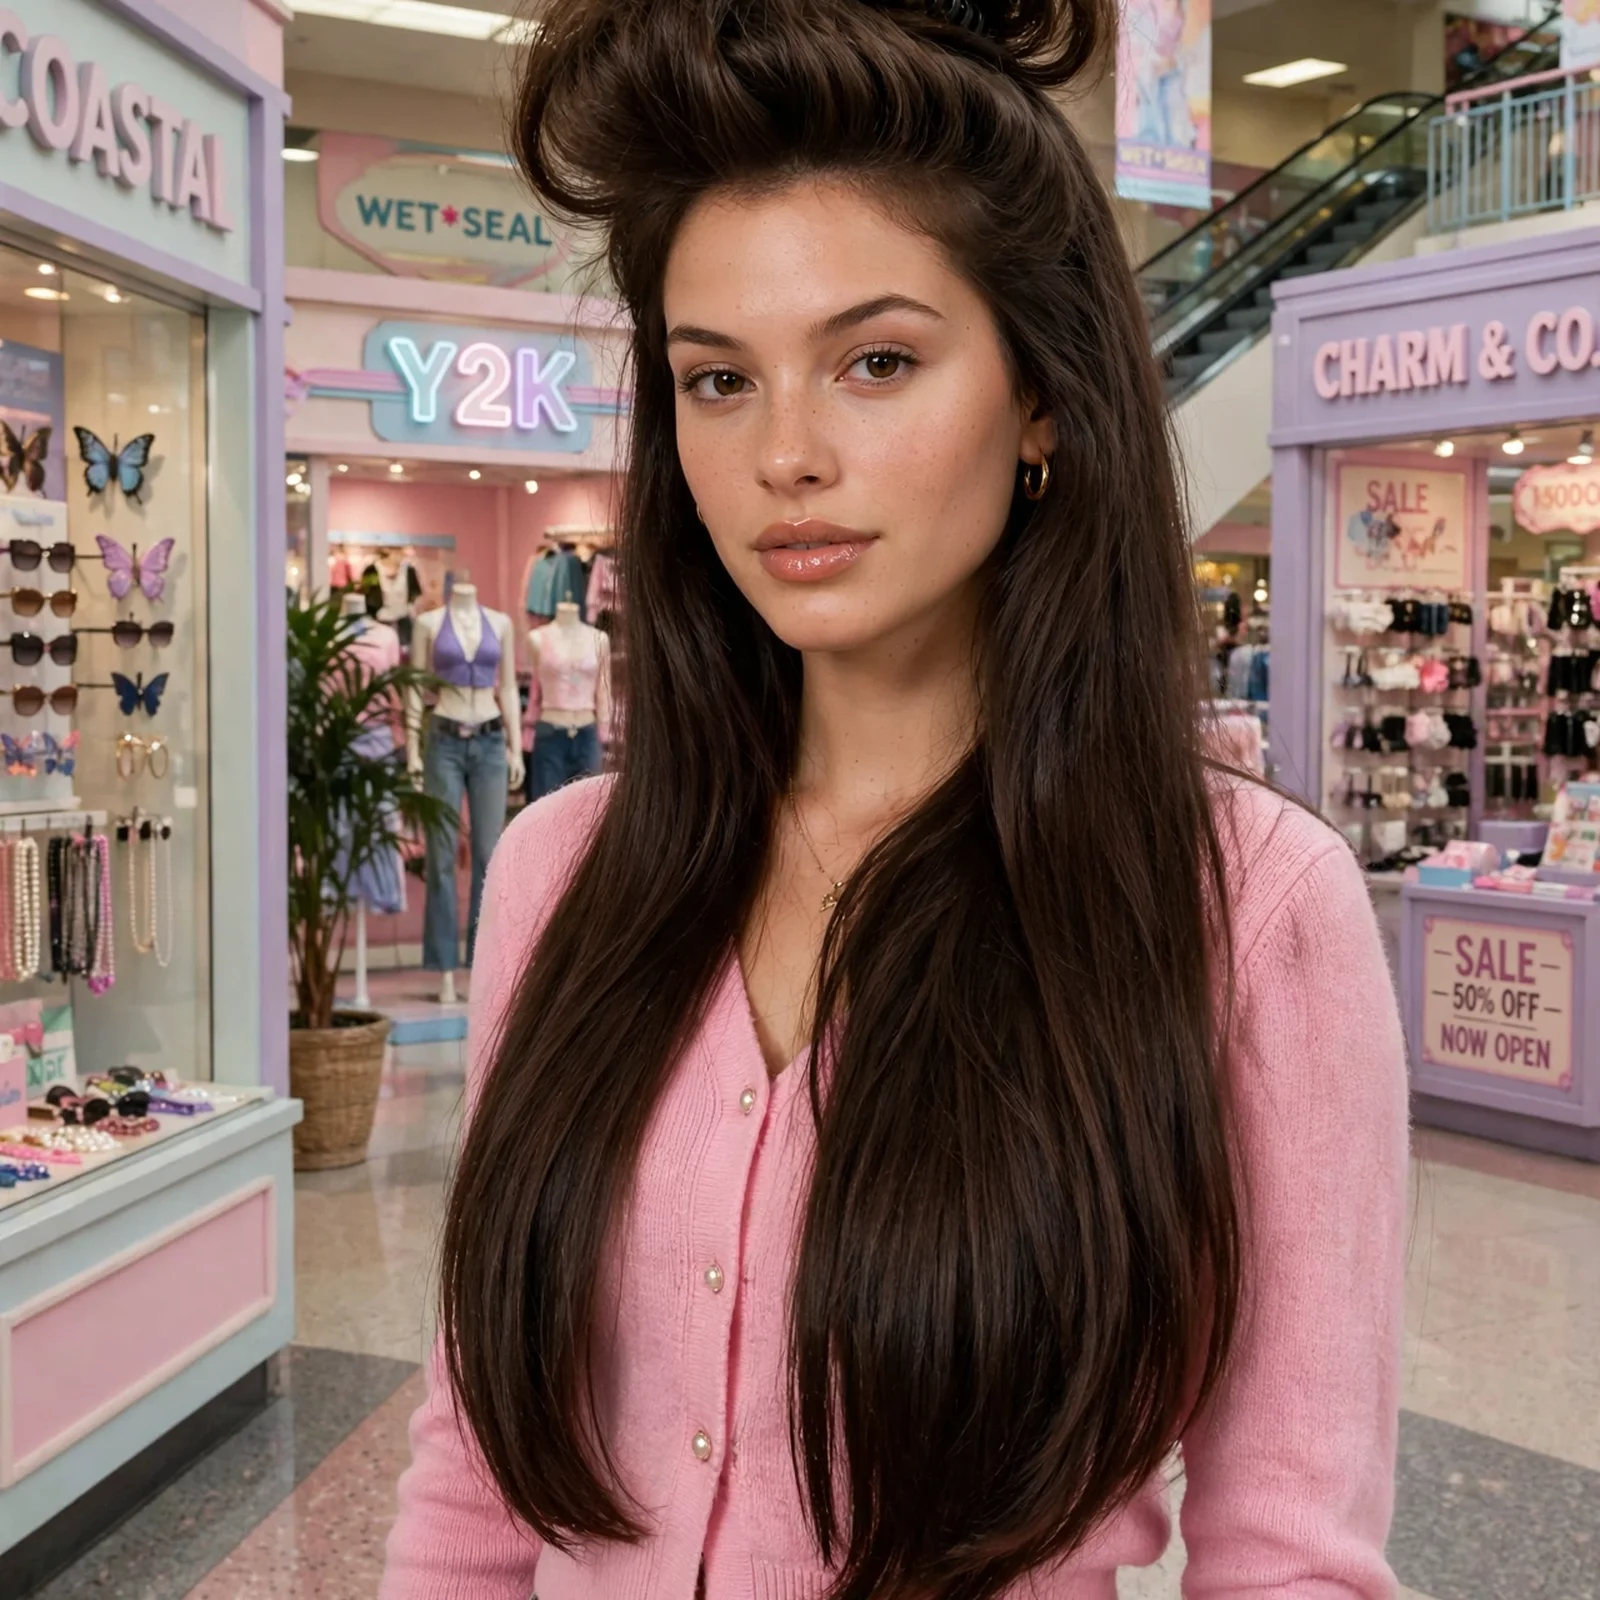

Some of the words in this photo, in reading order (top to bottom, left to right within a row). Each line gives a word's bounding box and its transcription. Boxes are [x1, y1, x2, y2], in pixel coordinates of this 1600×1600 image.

[0, 8, 234, 233] COASTAL
[356, 194, 439, 234] WET
[463, 206, 554, 246] SEAL
[1313, 324, 1468, 400] CHARM
[1478, 319, 1516, 381] &
[1525, 305, 1600, 375] CO.
[387, 336, 578, 432] Y2K
[1366, 479, 1429, 514] SALE
[1455, 934, 1538, 985] SALE
[1452, 981, 1496, 1015] 50%
[1501, 988, 1541, 1021] OFF
[1440, 1022, 1488, 1058] NOW
[1495, 1031, 1551, 1070] OPEN
